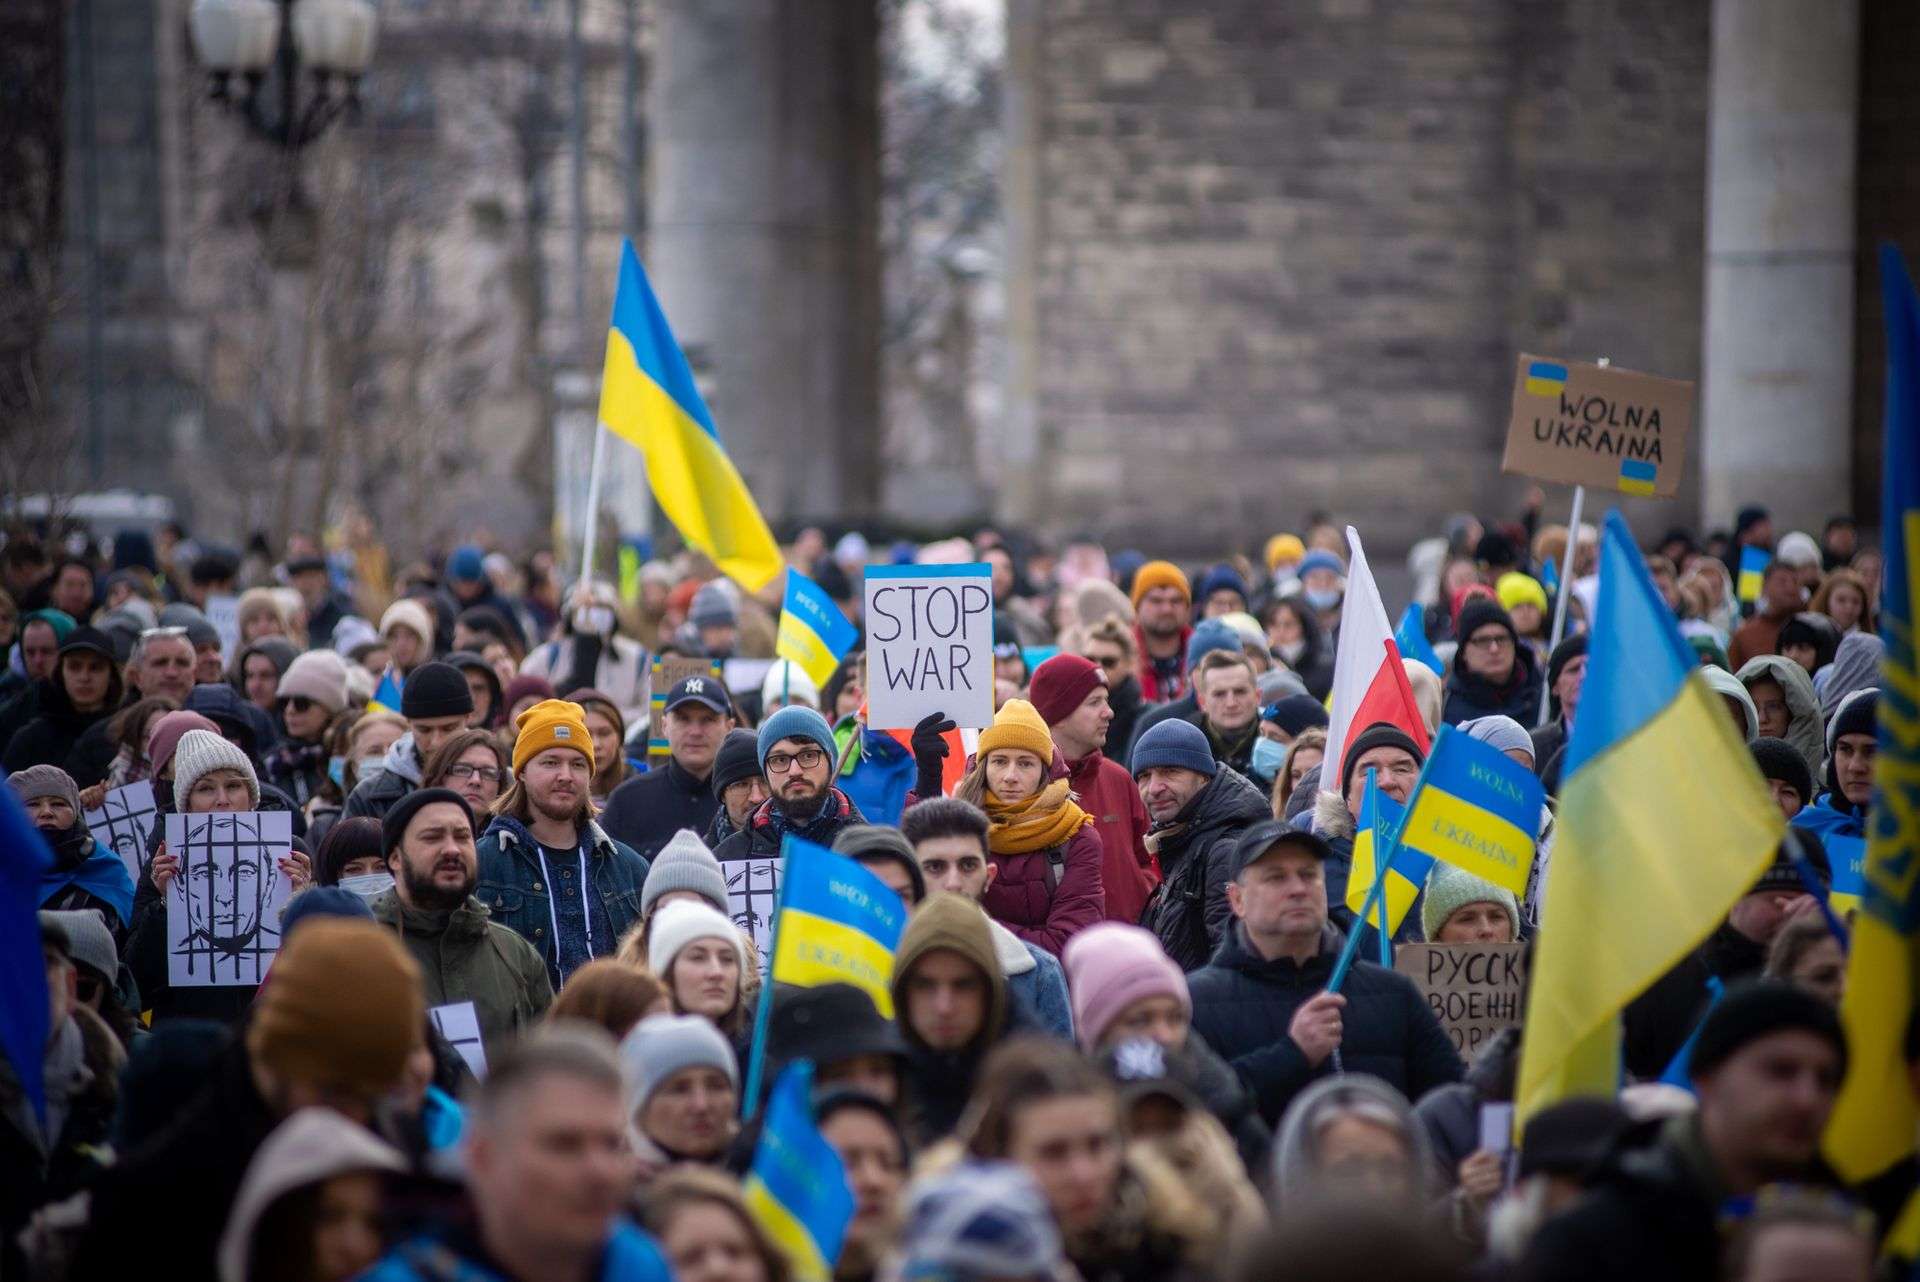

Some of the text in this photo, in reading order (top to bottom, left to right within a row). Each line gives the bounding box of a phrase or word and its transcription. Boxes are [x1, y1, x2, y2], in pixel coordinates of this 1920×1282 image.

[1560, 391, 1662, 434] WOLNA
[1533, 417, 1663, 464] UKRAINA
[872, 585, 990, 642] STOP
[685, 678, 704, 694] NY
[882, 644, 973, 691] WAR
[1470, 761, 1526, 806] WOLNA
[1428, 949, 1520, 986] РУССК
[1428, 992, 1517, 1022] ВОЕНН
